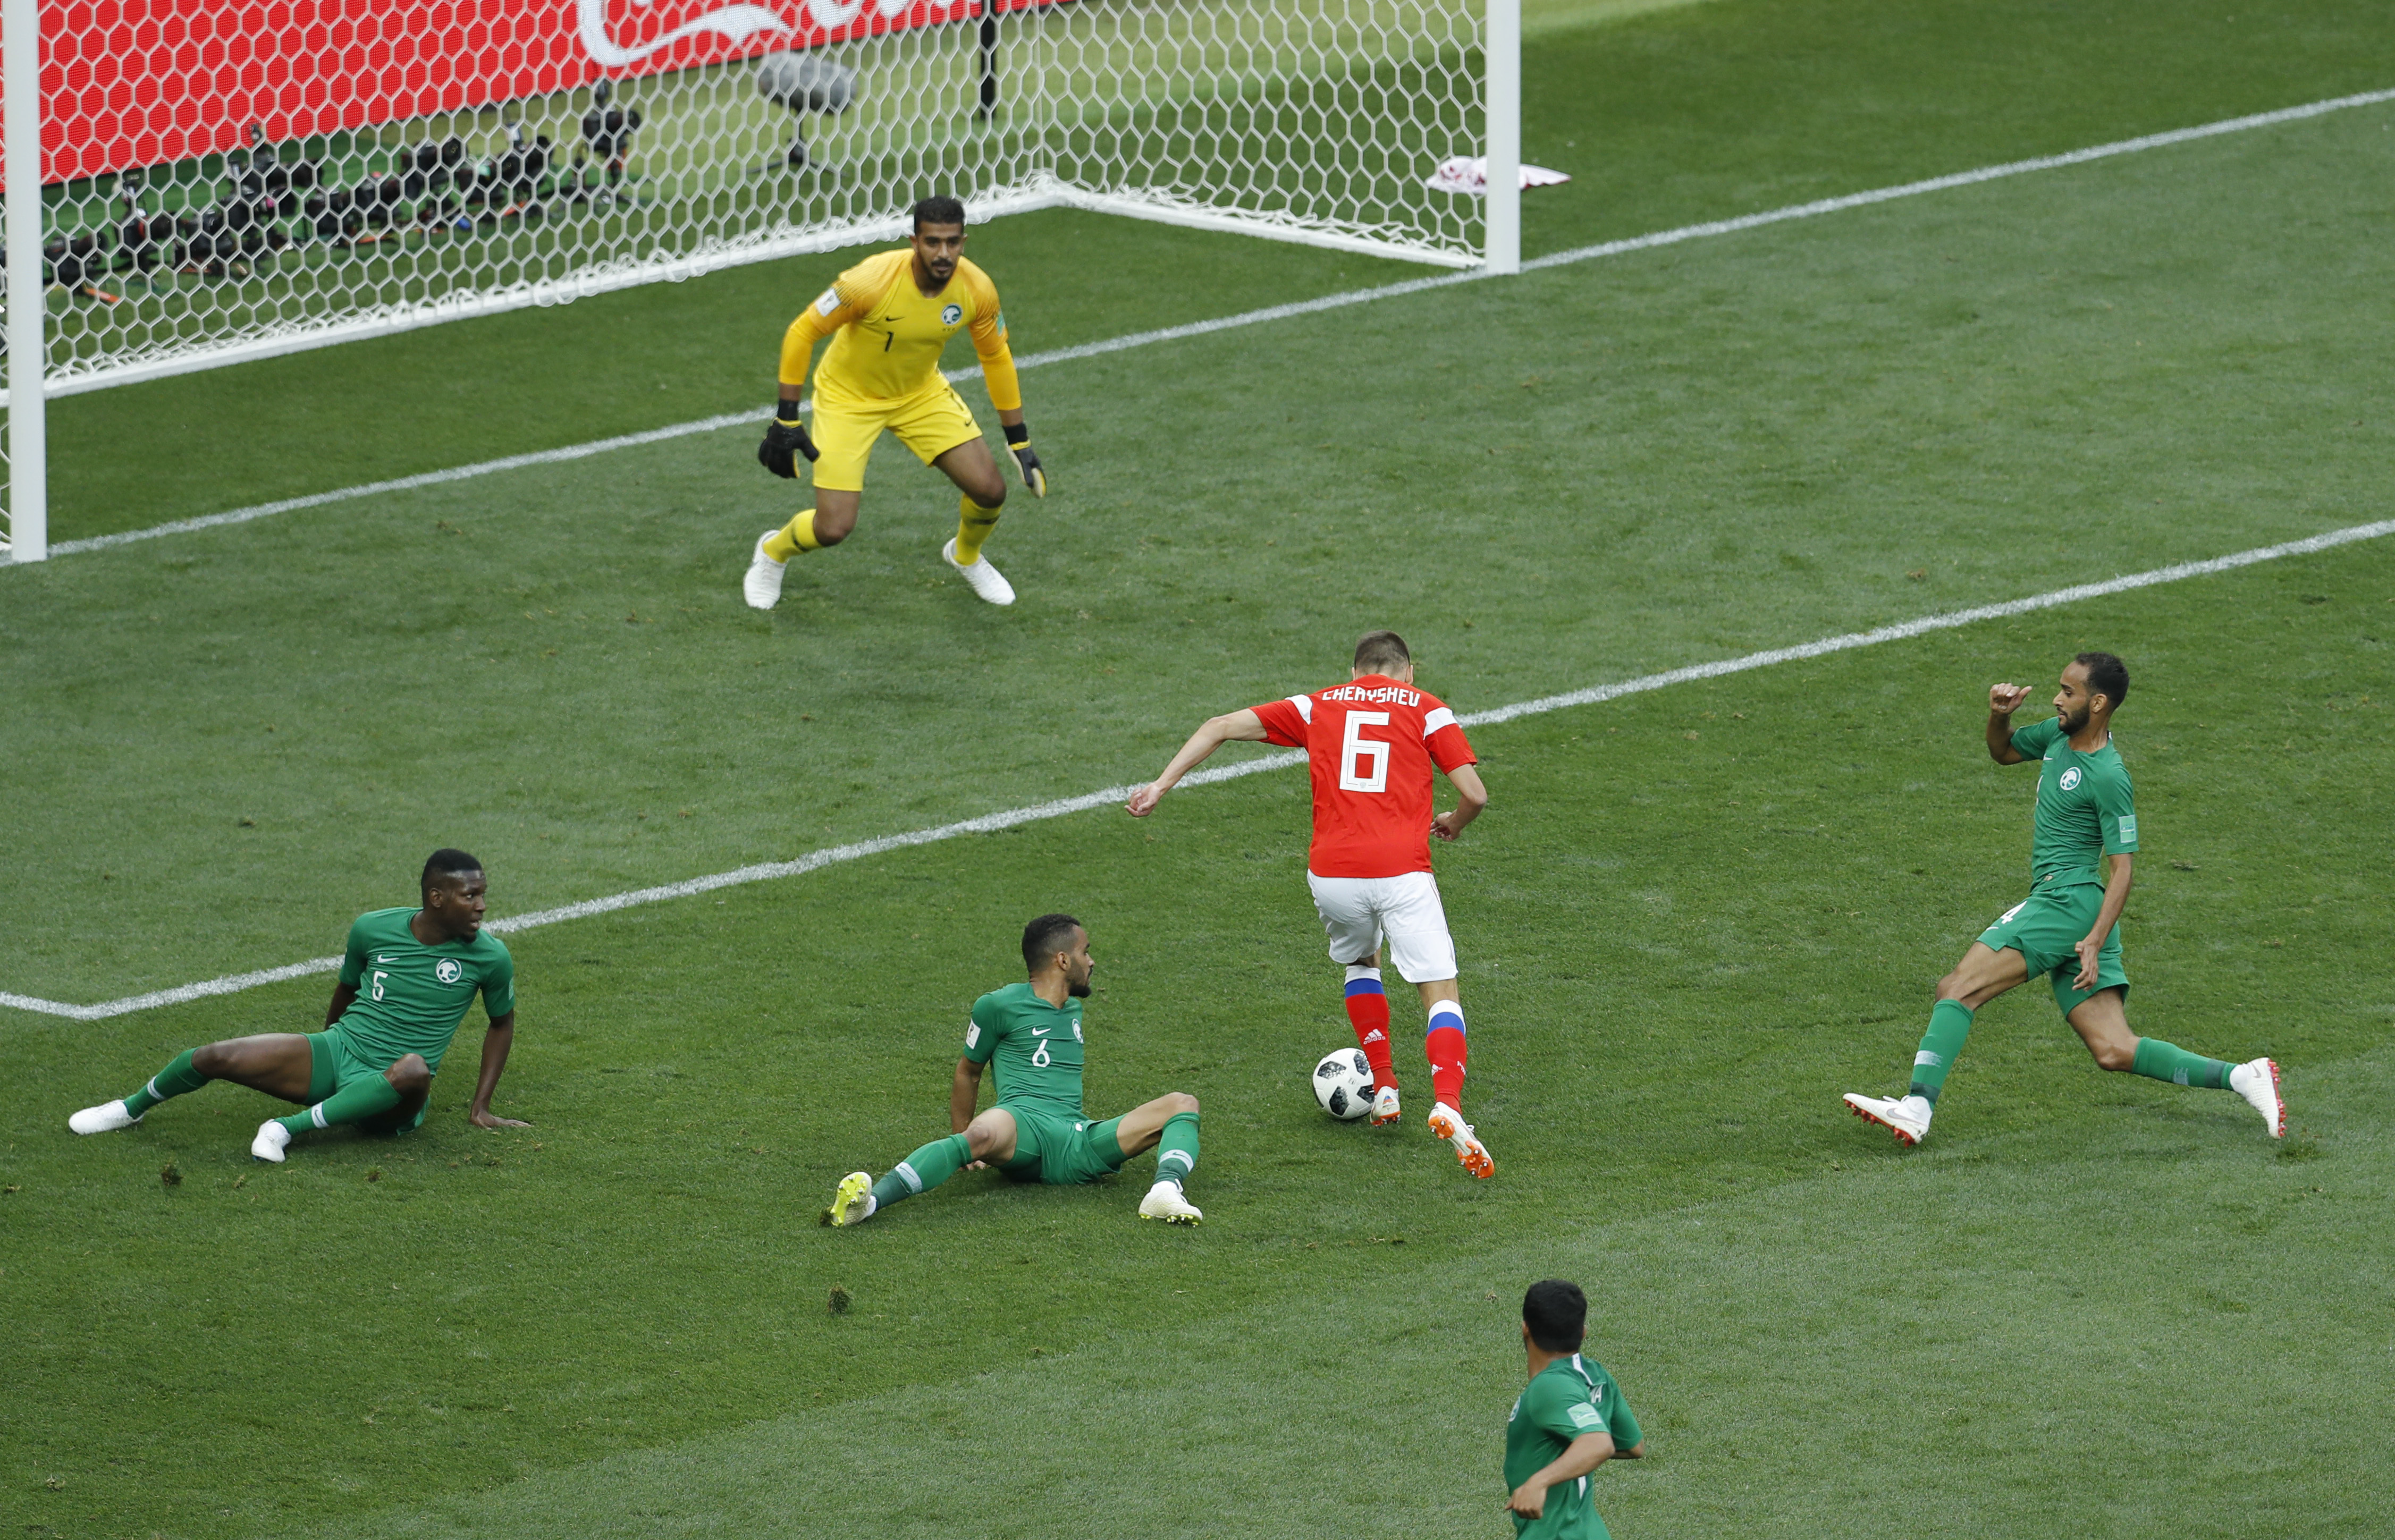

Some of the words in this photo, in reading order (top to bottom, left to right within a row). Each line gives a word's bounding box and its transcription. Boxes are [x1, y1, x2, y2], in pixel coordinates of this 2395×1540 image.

[884, 332, 895, 353] 1
[1322, 686, 1421, 707] CHERYSHEV
[1339, 710, 1390, 793] 6
[372, 970, 389, 1002] 5
[1032, 1038, 1051, 1068] 6
[1363, 1036, 1386, 1045] adidas
